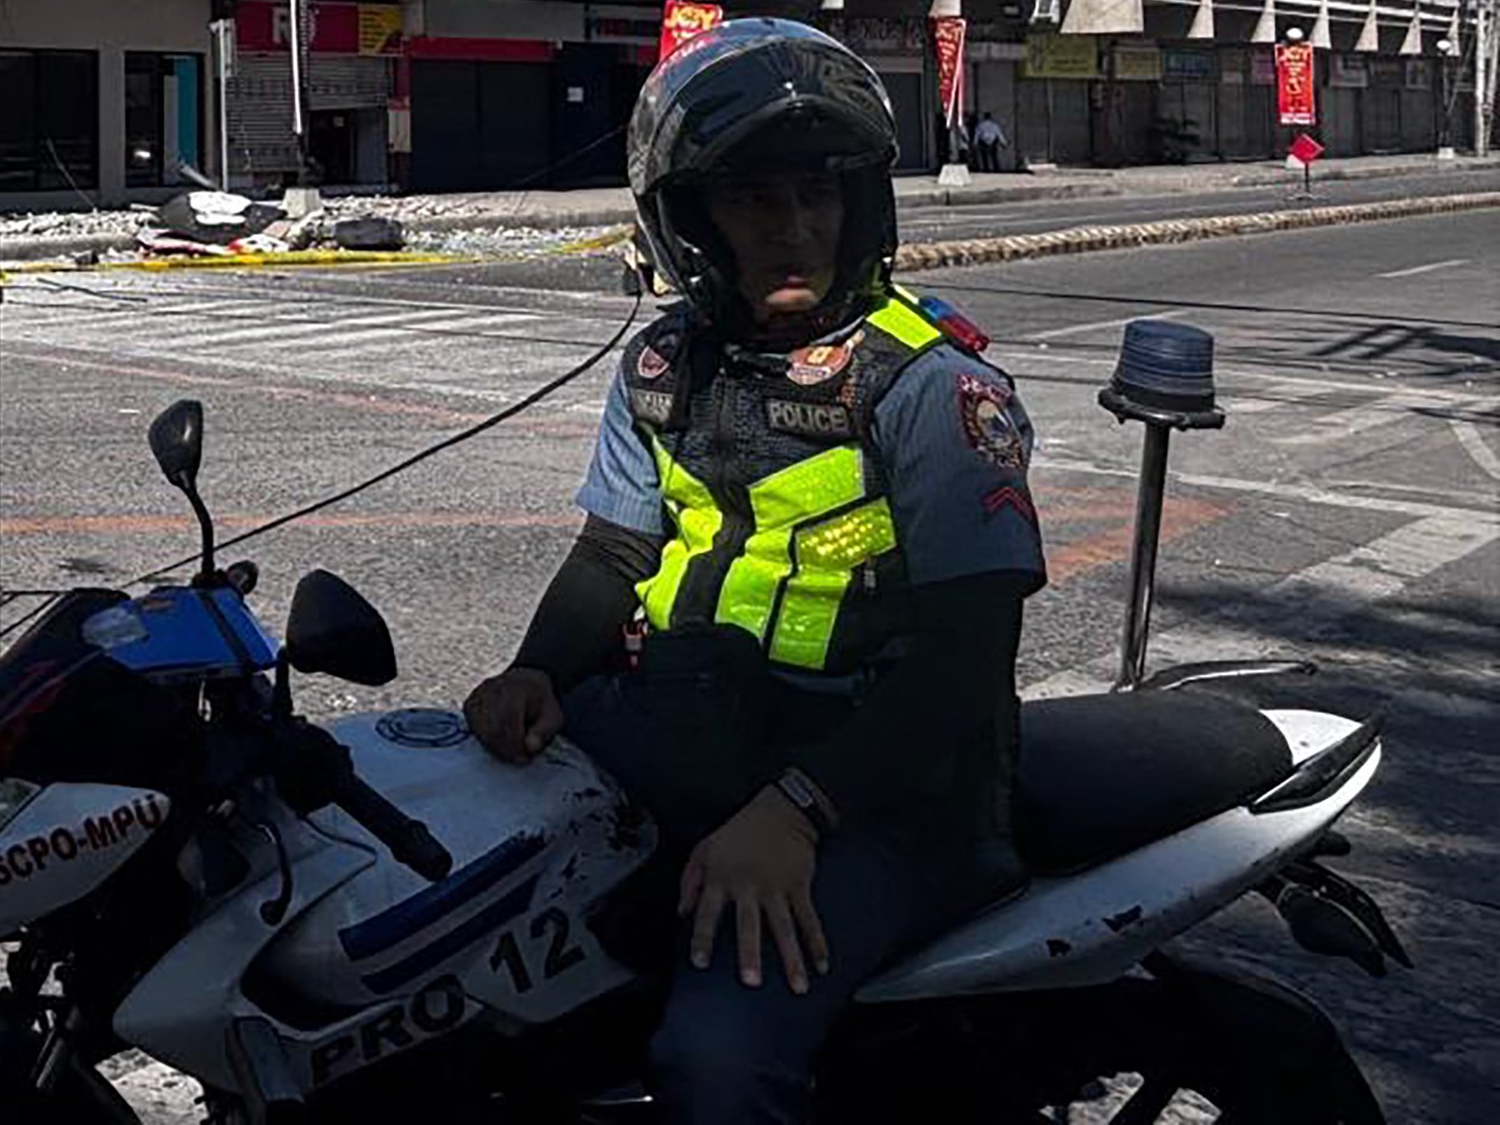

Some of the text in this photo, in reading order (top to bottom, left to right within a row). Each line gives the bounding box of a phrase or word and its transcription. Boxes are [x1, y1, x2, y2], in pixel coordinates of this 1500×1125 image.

[770, 401, 847, 429] POLICE
[310, 907, 587, 1087] PRO 12
